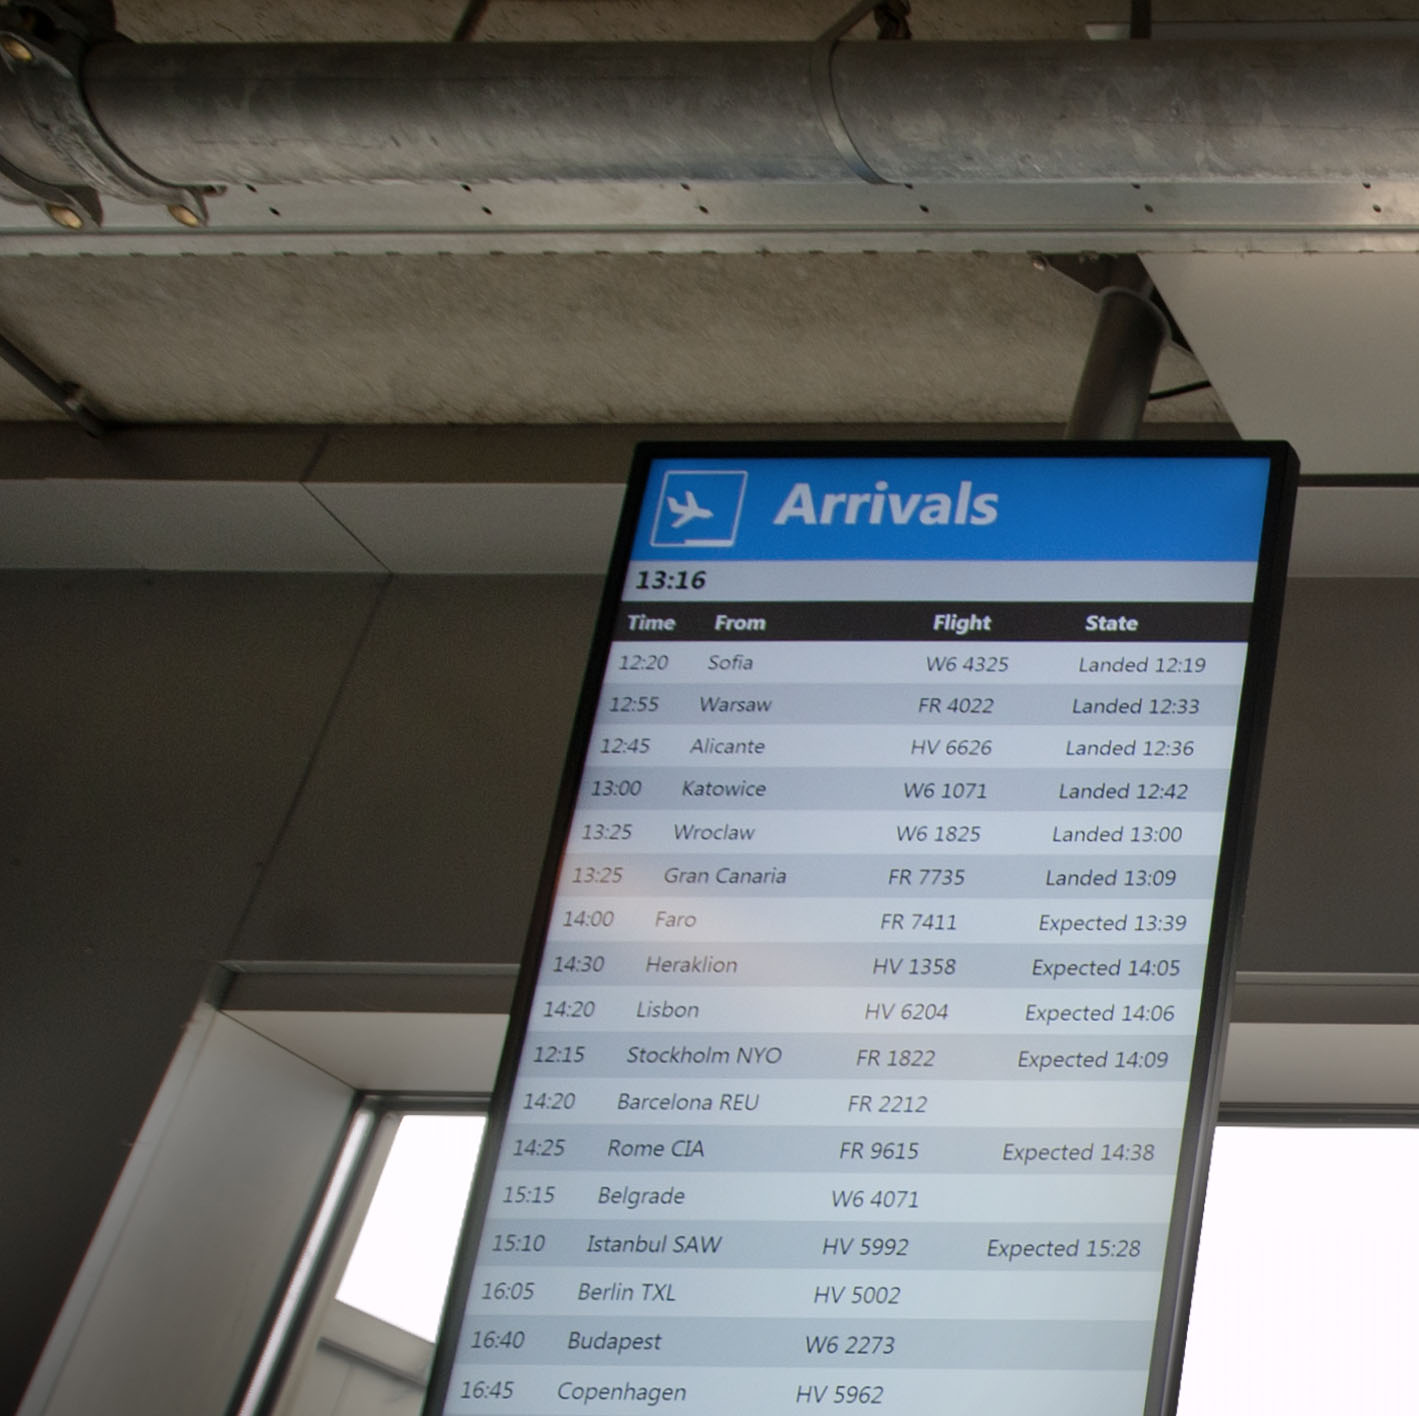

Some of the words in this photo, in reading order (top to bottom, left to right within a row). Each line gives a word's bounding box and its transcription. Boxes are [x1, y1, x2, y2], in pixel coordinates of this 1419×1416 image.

[774, 479, 999, 526] Arrivals
[635, 570, 707, 590] 13:16
[627, 613, 677, 631] Time
[714, 614, 767, 631] From
[933, 613, 993, 636] Flight
[1085, 614, 1139, 632] State
[619, 654, 670, 671] 12:20
[707, 653, 754, 671] Sofia
[926, 656, 958, 672] W6
[962, 656, 1009, 673] 4325
[1079, 656, 1149, 673] Landed
[1155, 657, 1207, 673] 12:19
[600, 737, 651, 754] 12:45
[689, 737, 766, 755] Alicante
[910, 739, 941, 755] HV
[945, 739, 993, 756] 6626
[1065, 739, 1137, 757] Landed
[1142, 740, 1195, 757] 12:36
[582, 823, 633, 841] 13:25
[674, 823, 756, 841] Wroclaw
[896, 825, 928, 842] W6
[934, 825, 981, 843] 1825
[1052, 825, 1124, 843] Landed
[1130, 826, 1183, 843] 13:00
[563, 910, 615, 928] 14:00
[655, 910, 697, 928] Faro
[880, 913, 905, 930] FR
[912, 913, 957, 931] 7411
[1039, 914, 1128, 936] Expected
[1134, 914, 1187, 932] 13:39
[543, 1000, 596, 1018] 14:20
[636, 999, 700, 1019] Lisbon
[864, 1003, 896, 1020] HV
[900, 1003, 949, 1021] 6204
[1025, 1003, 1115, 1026] Expected
[1121, 1004, 1175, 1022] 14:06
[523, 1092, 576, 1110] 14:20
[617, 1092, 713, 1111] Barcelona
[719, 1093, 760, 1112] REU
[847, 1095, 873, 1113] FR
[877, 1095, 928, 1113] 2212
[503, 1185, 556, 1204] 15:15
[597, 1186, 686, 1210] Belgrade
[832, 1190, 865, 1208] W6
[869, 1190, 919, 1209] 4071
[482, 1281, 536, 1301] 16:05
[577, 1282, 635, 1301] Berlin
[641, 1283, 676, 1302] TXL
[813, 1285, 847, 1304] HV
[851, 1285, 901, 1305] 5002
[460, 1380, 515, 1400] 16:45
[557, 1381, 687, 1407] Copenhagen
[795, 1385, 829, 1404] HV
[833, 1385, 884, 1405] 5962
